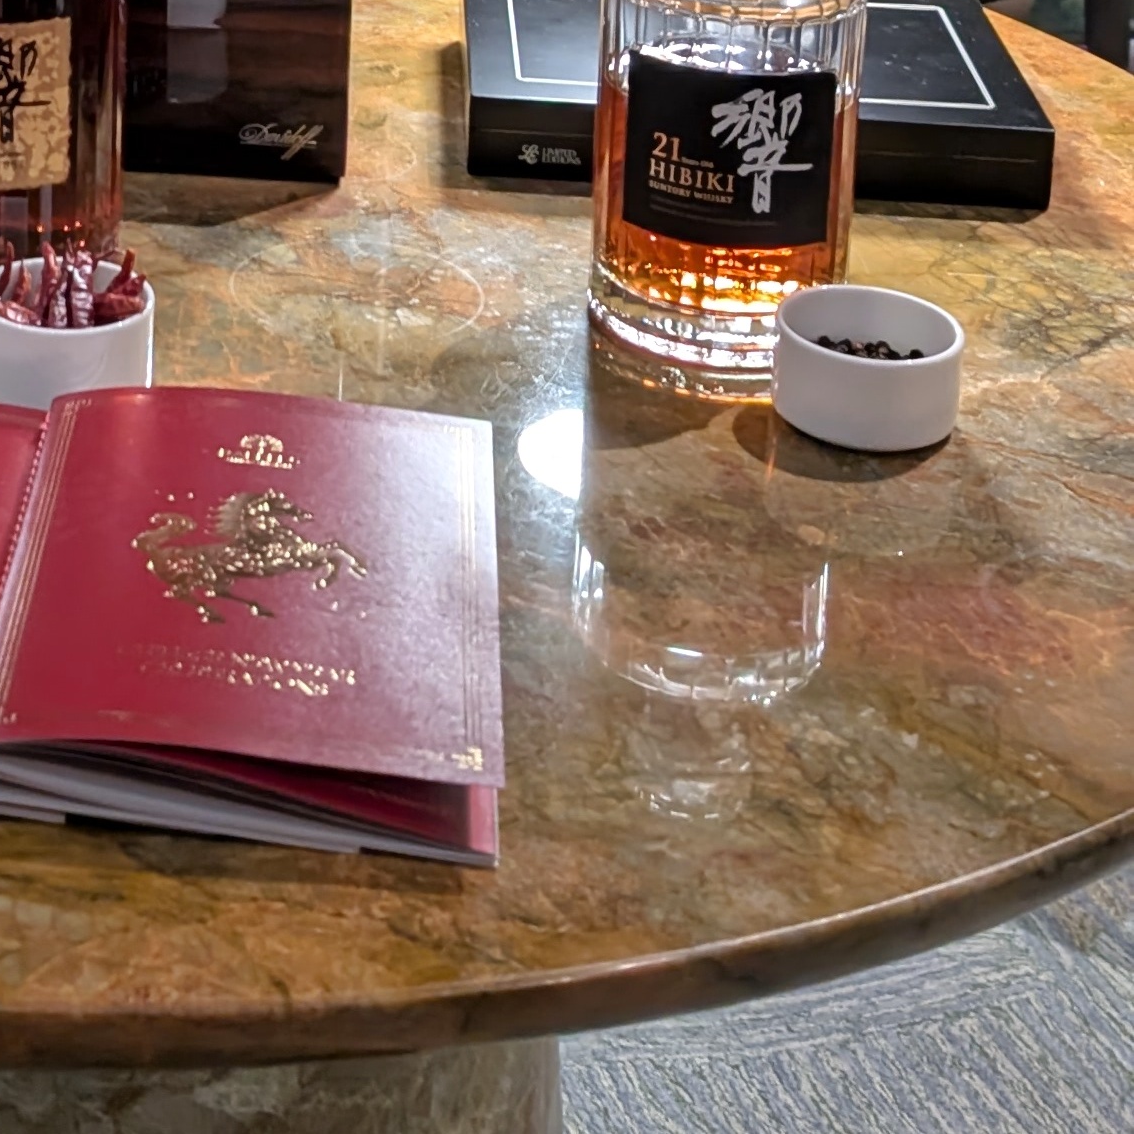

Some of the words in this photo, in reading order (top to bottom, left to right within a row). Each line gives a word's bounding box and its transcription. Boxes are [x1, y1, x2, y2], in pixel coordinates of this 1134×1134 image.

[651, 131, 681, 162] 21
[648, 157, 736, 193] HIBIKI
[648, 179, 692, 197] SUNTORY
[693, 190, 735, 204] WHISKY
